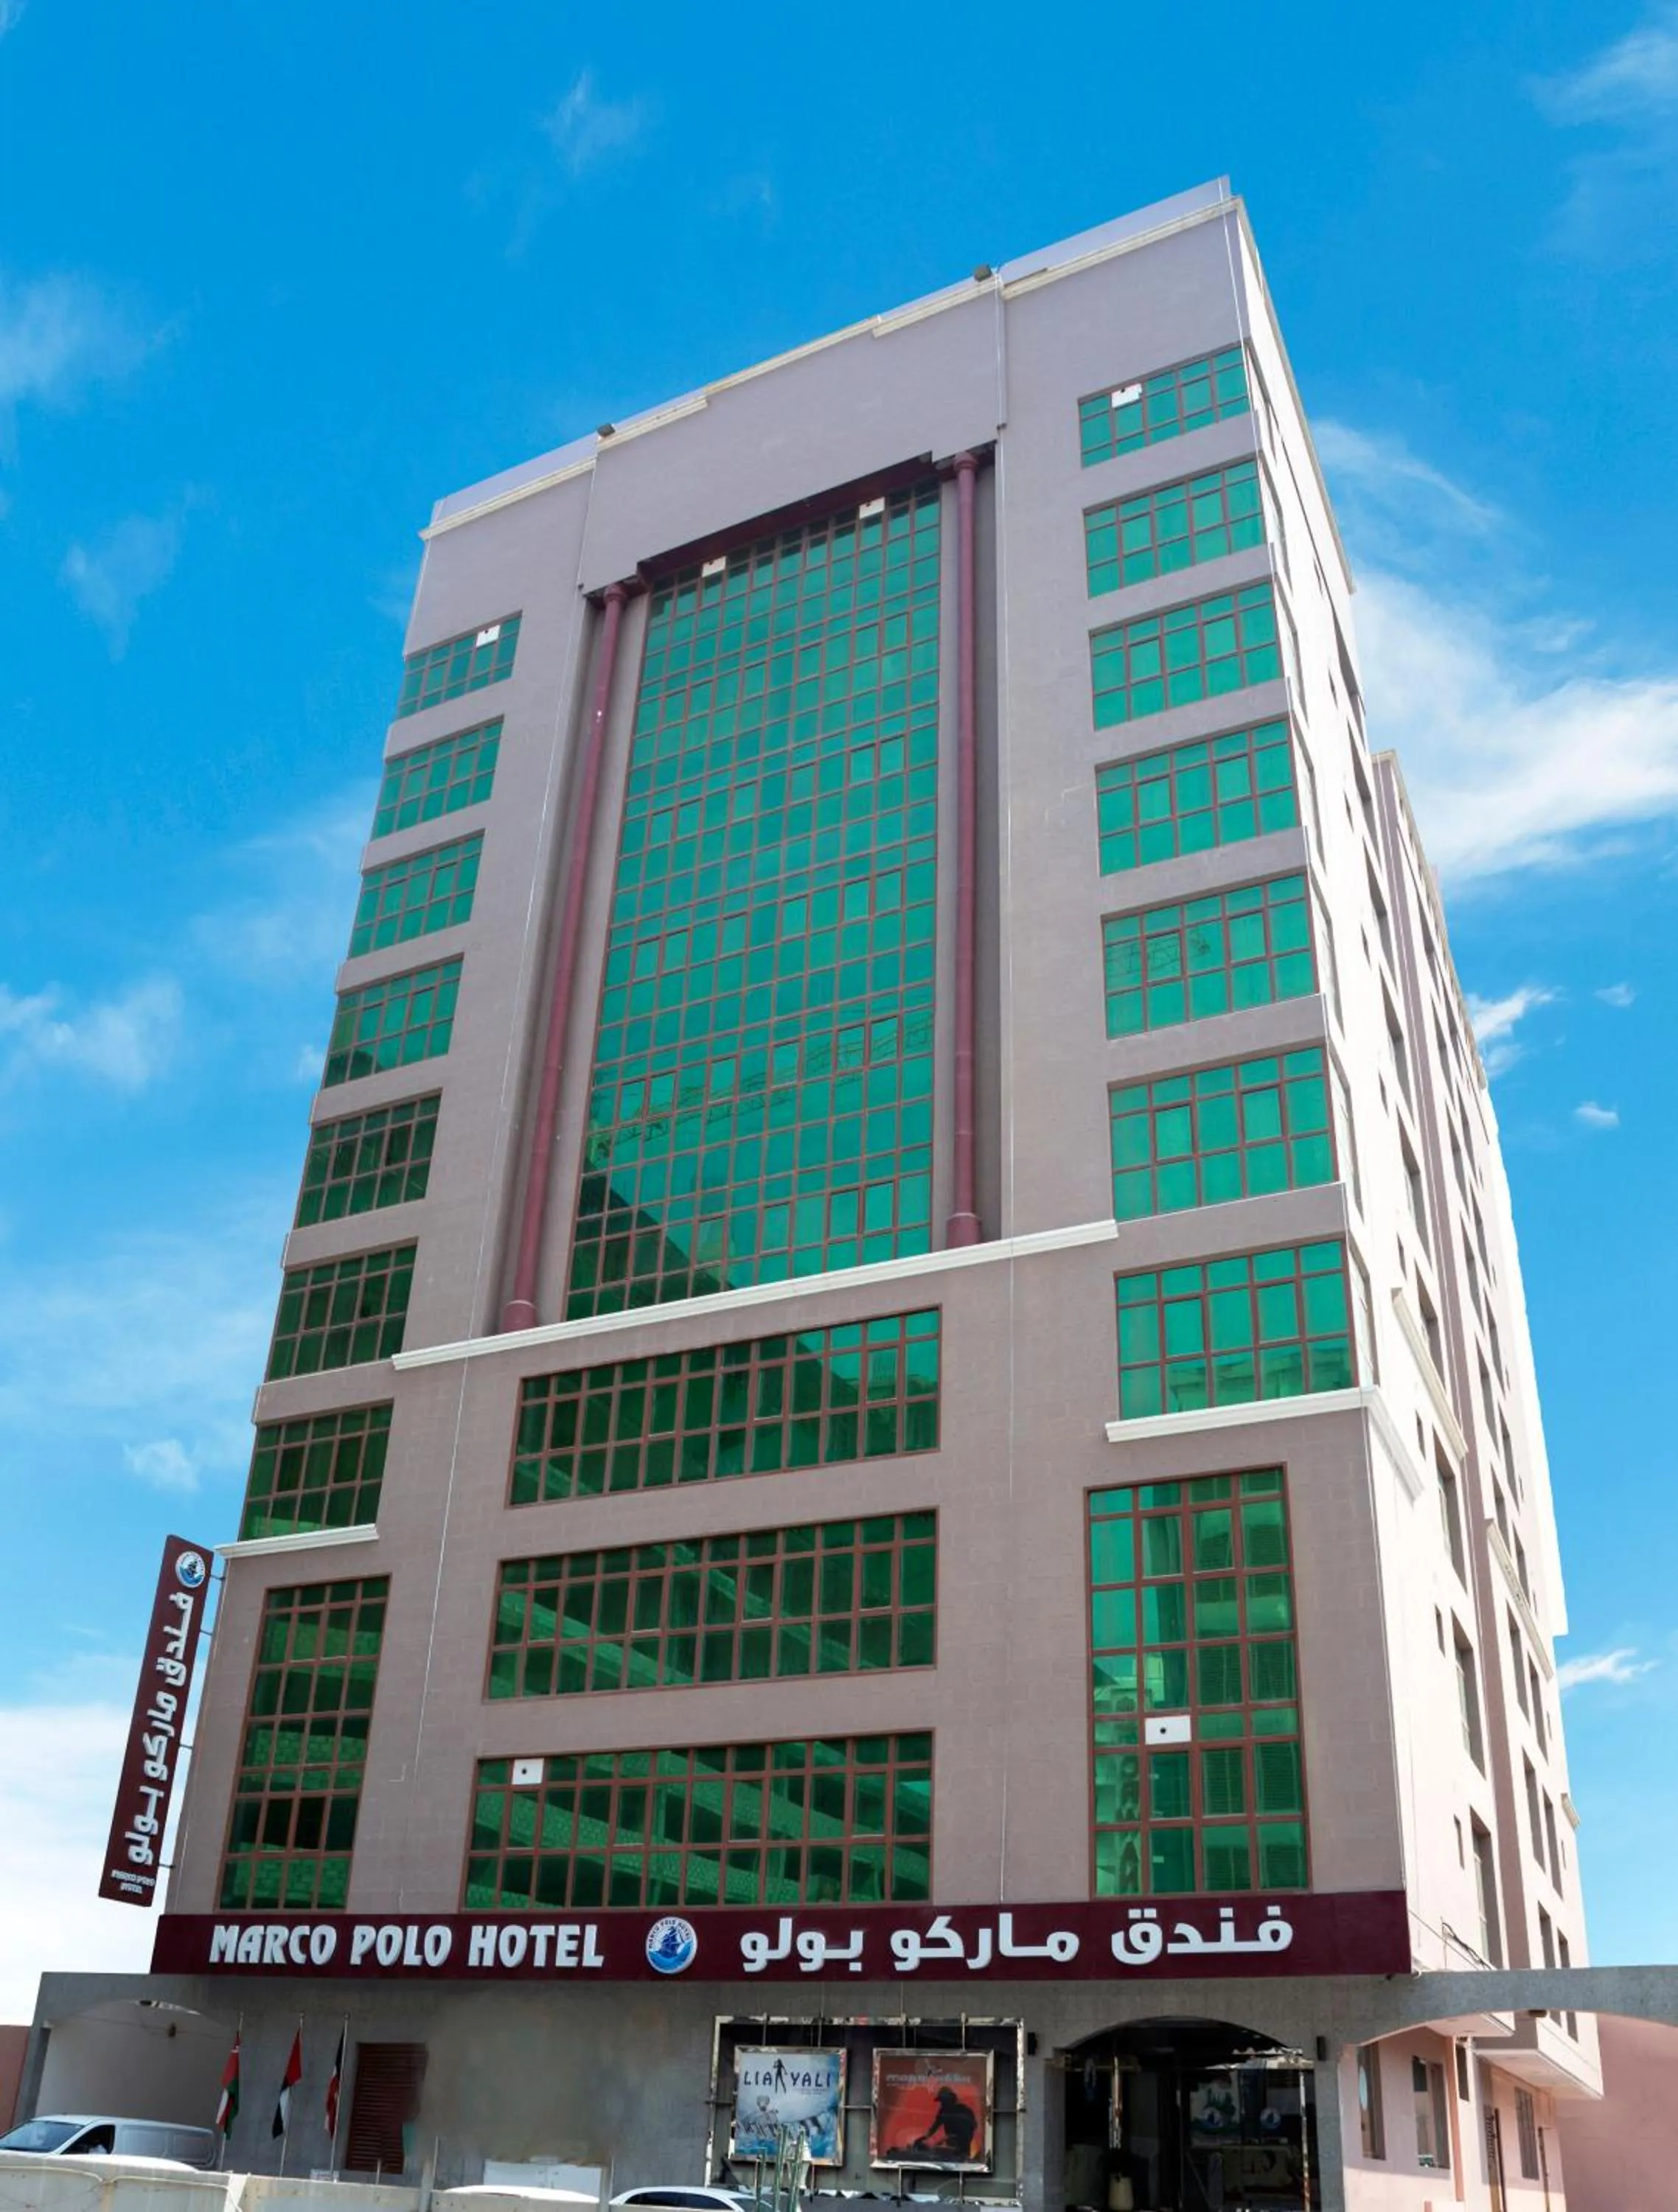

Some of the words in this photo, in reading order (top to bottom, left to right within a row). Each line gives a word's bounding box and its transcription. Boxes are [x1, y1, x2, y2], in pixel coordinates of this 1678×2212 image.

[156, 1592, 194, 1687] فندق
[143, 1691, 178, 1782] ماركو
[125, 1785, 165, 1866] بولو
[209, 1924, 337, 1965] MARCO
[349, 1924, 452, 1966] POLO
[467, 1924, 605, 1967] HOTEL
[739, 1917, 863, 1972] بولو
[890, 1913, 1079, 1972] ماركو
[1111, 1906, 1293, 1965] فندق
